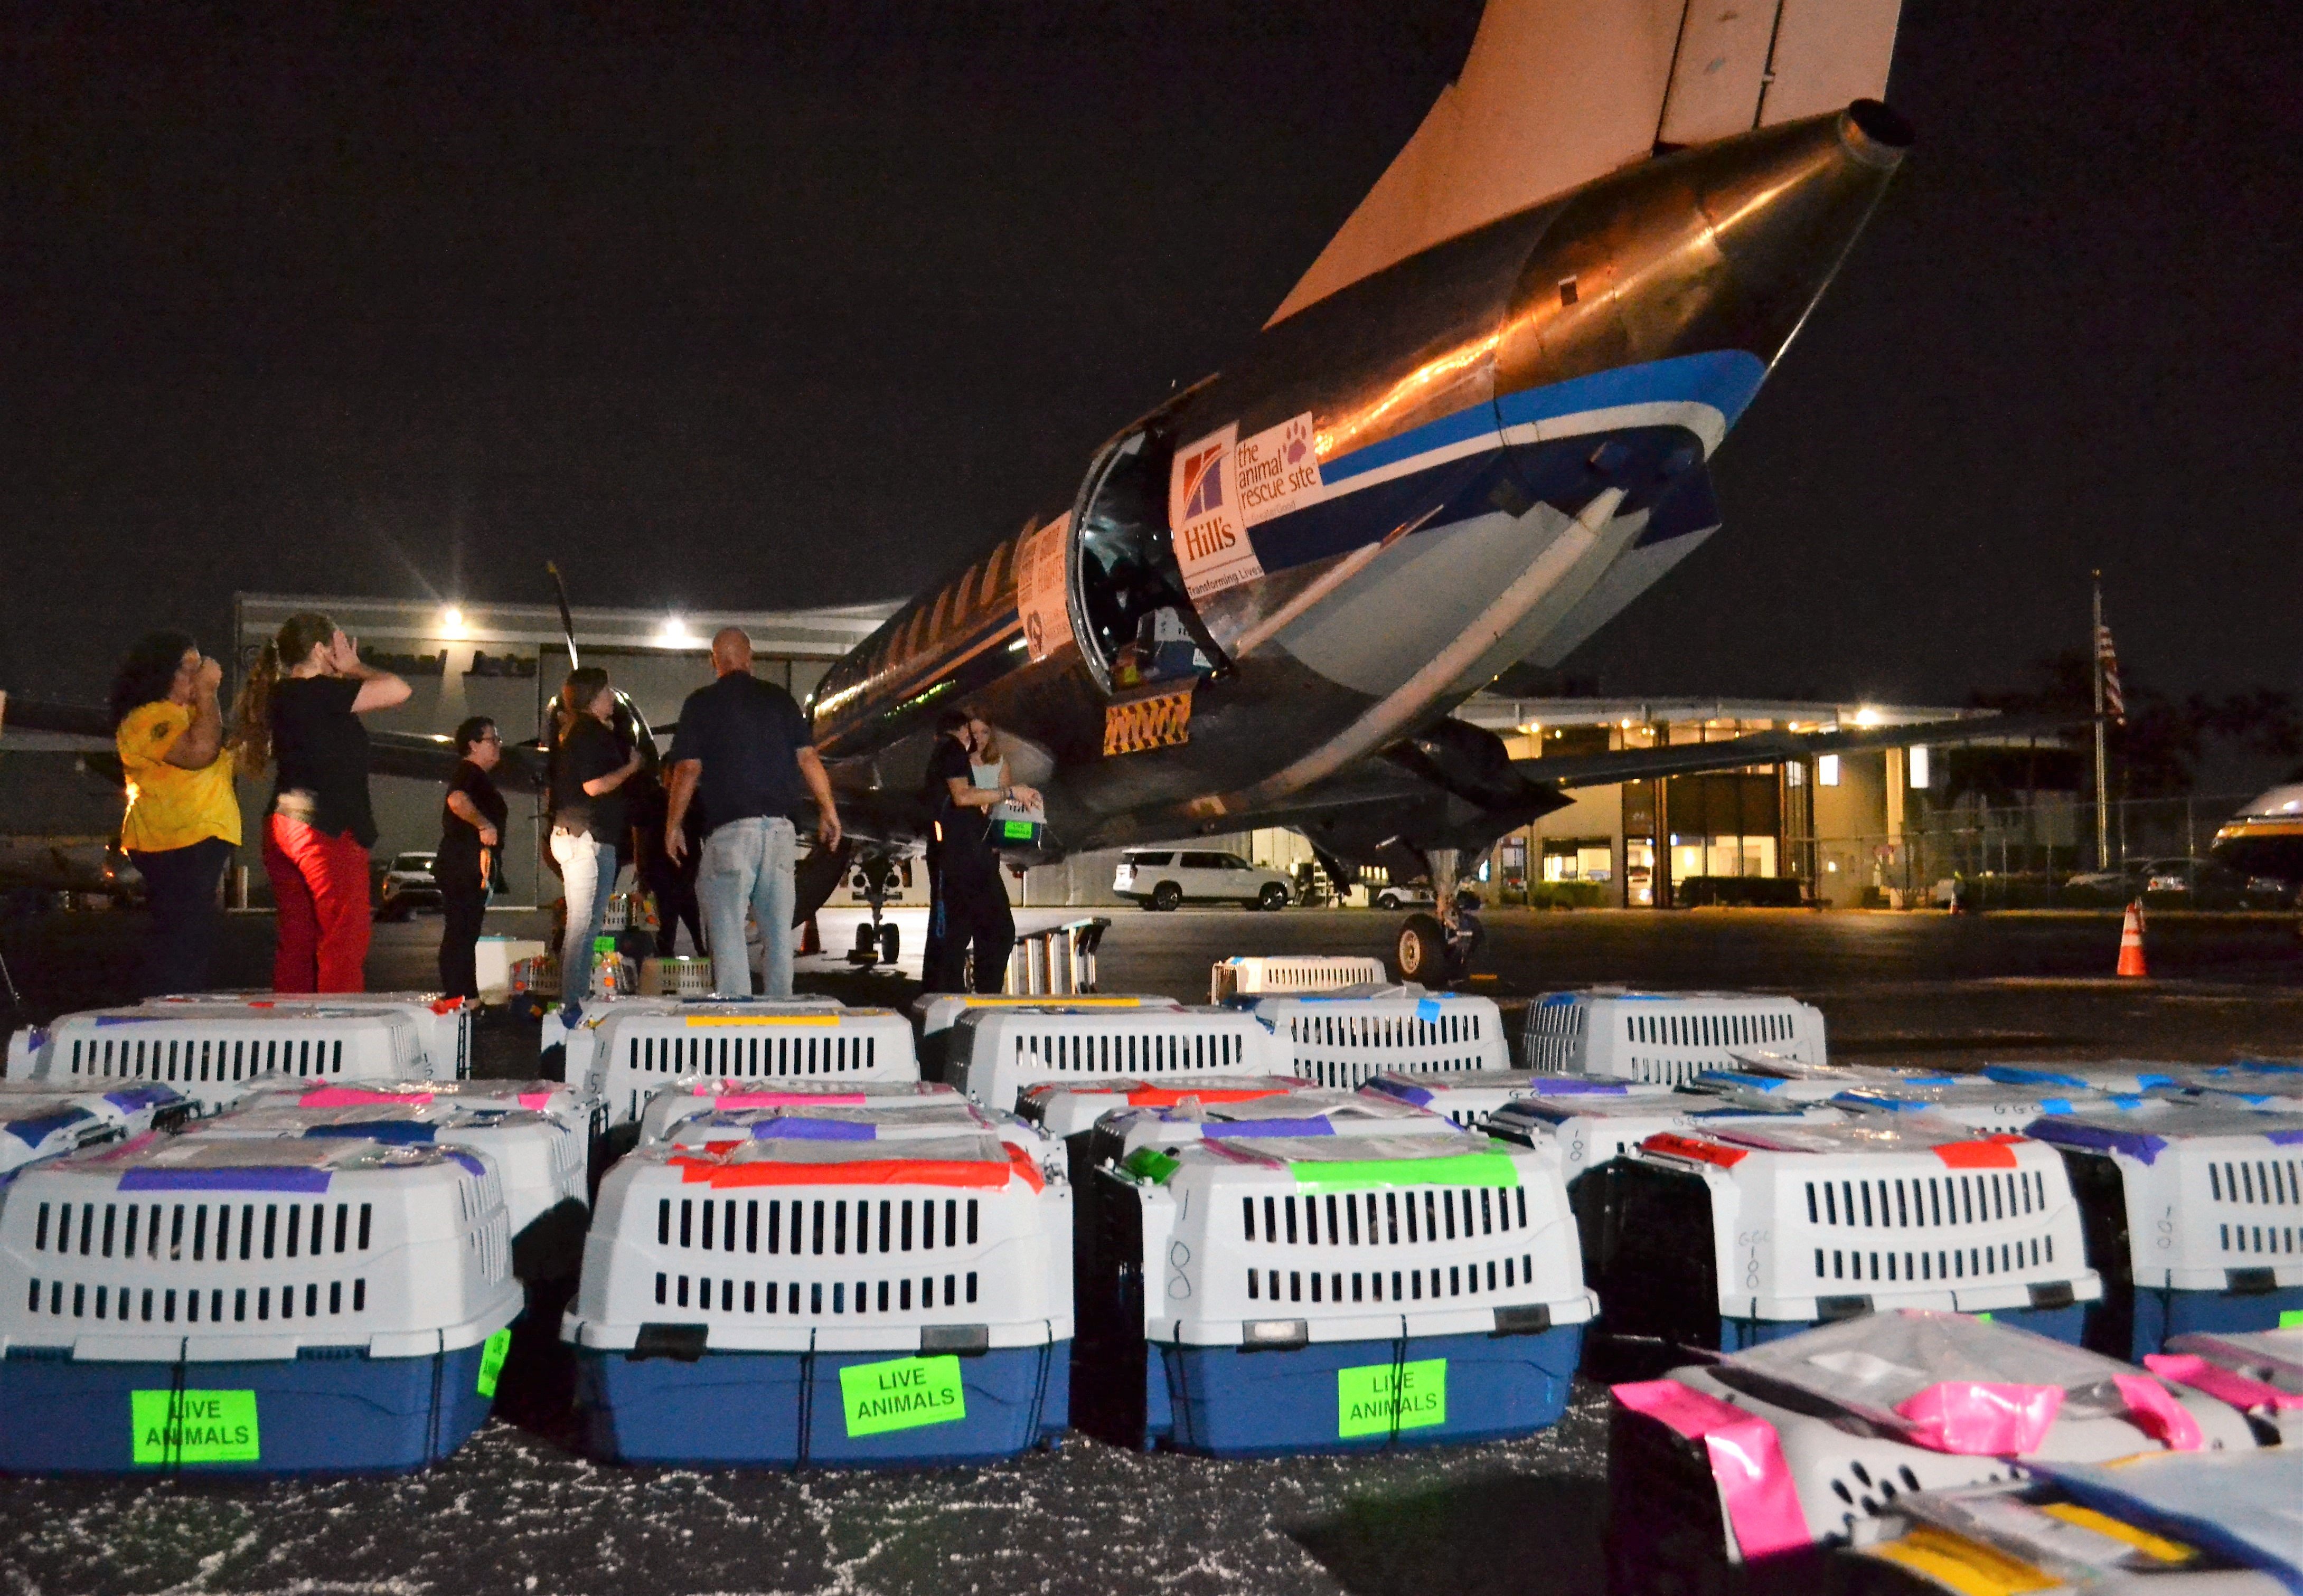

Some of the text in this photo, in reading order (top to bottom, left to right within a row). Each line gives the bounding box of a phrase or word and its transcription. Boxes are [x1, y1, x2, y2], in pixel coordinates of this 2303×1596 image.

[1238, 442, 1258, 468] the
[1239, 449, 1283, 489] animal
[1241, 465, 1316, 510] rescue site
[1184, 516, 1236, 561] Hill's
[1188, 573, 1239, 596] Transforming
[878, 1367, 926, 1390] LIVE
[1373, 1371, 1414, 1393] LIVE
[171, 1400, 221, 1419] LIVE
[858, 1388, 955, 1420] ANIMALS
[1350, 1392, 1437, 1420] ANIMALS
[146, 1425, 249, 1445] ANIMALS
